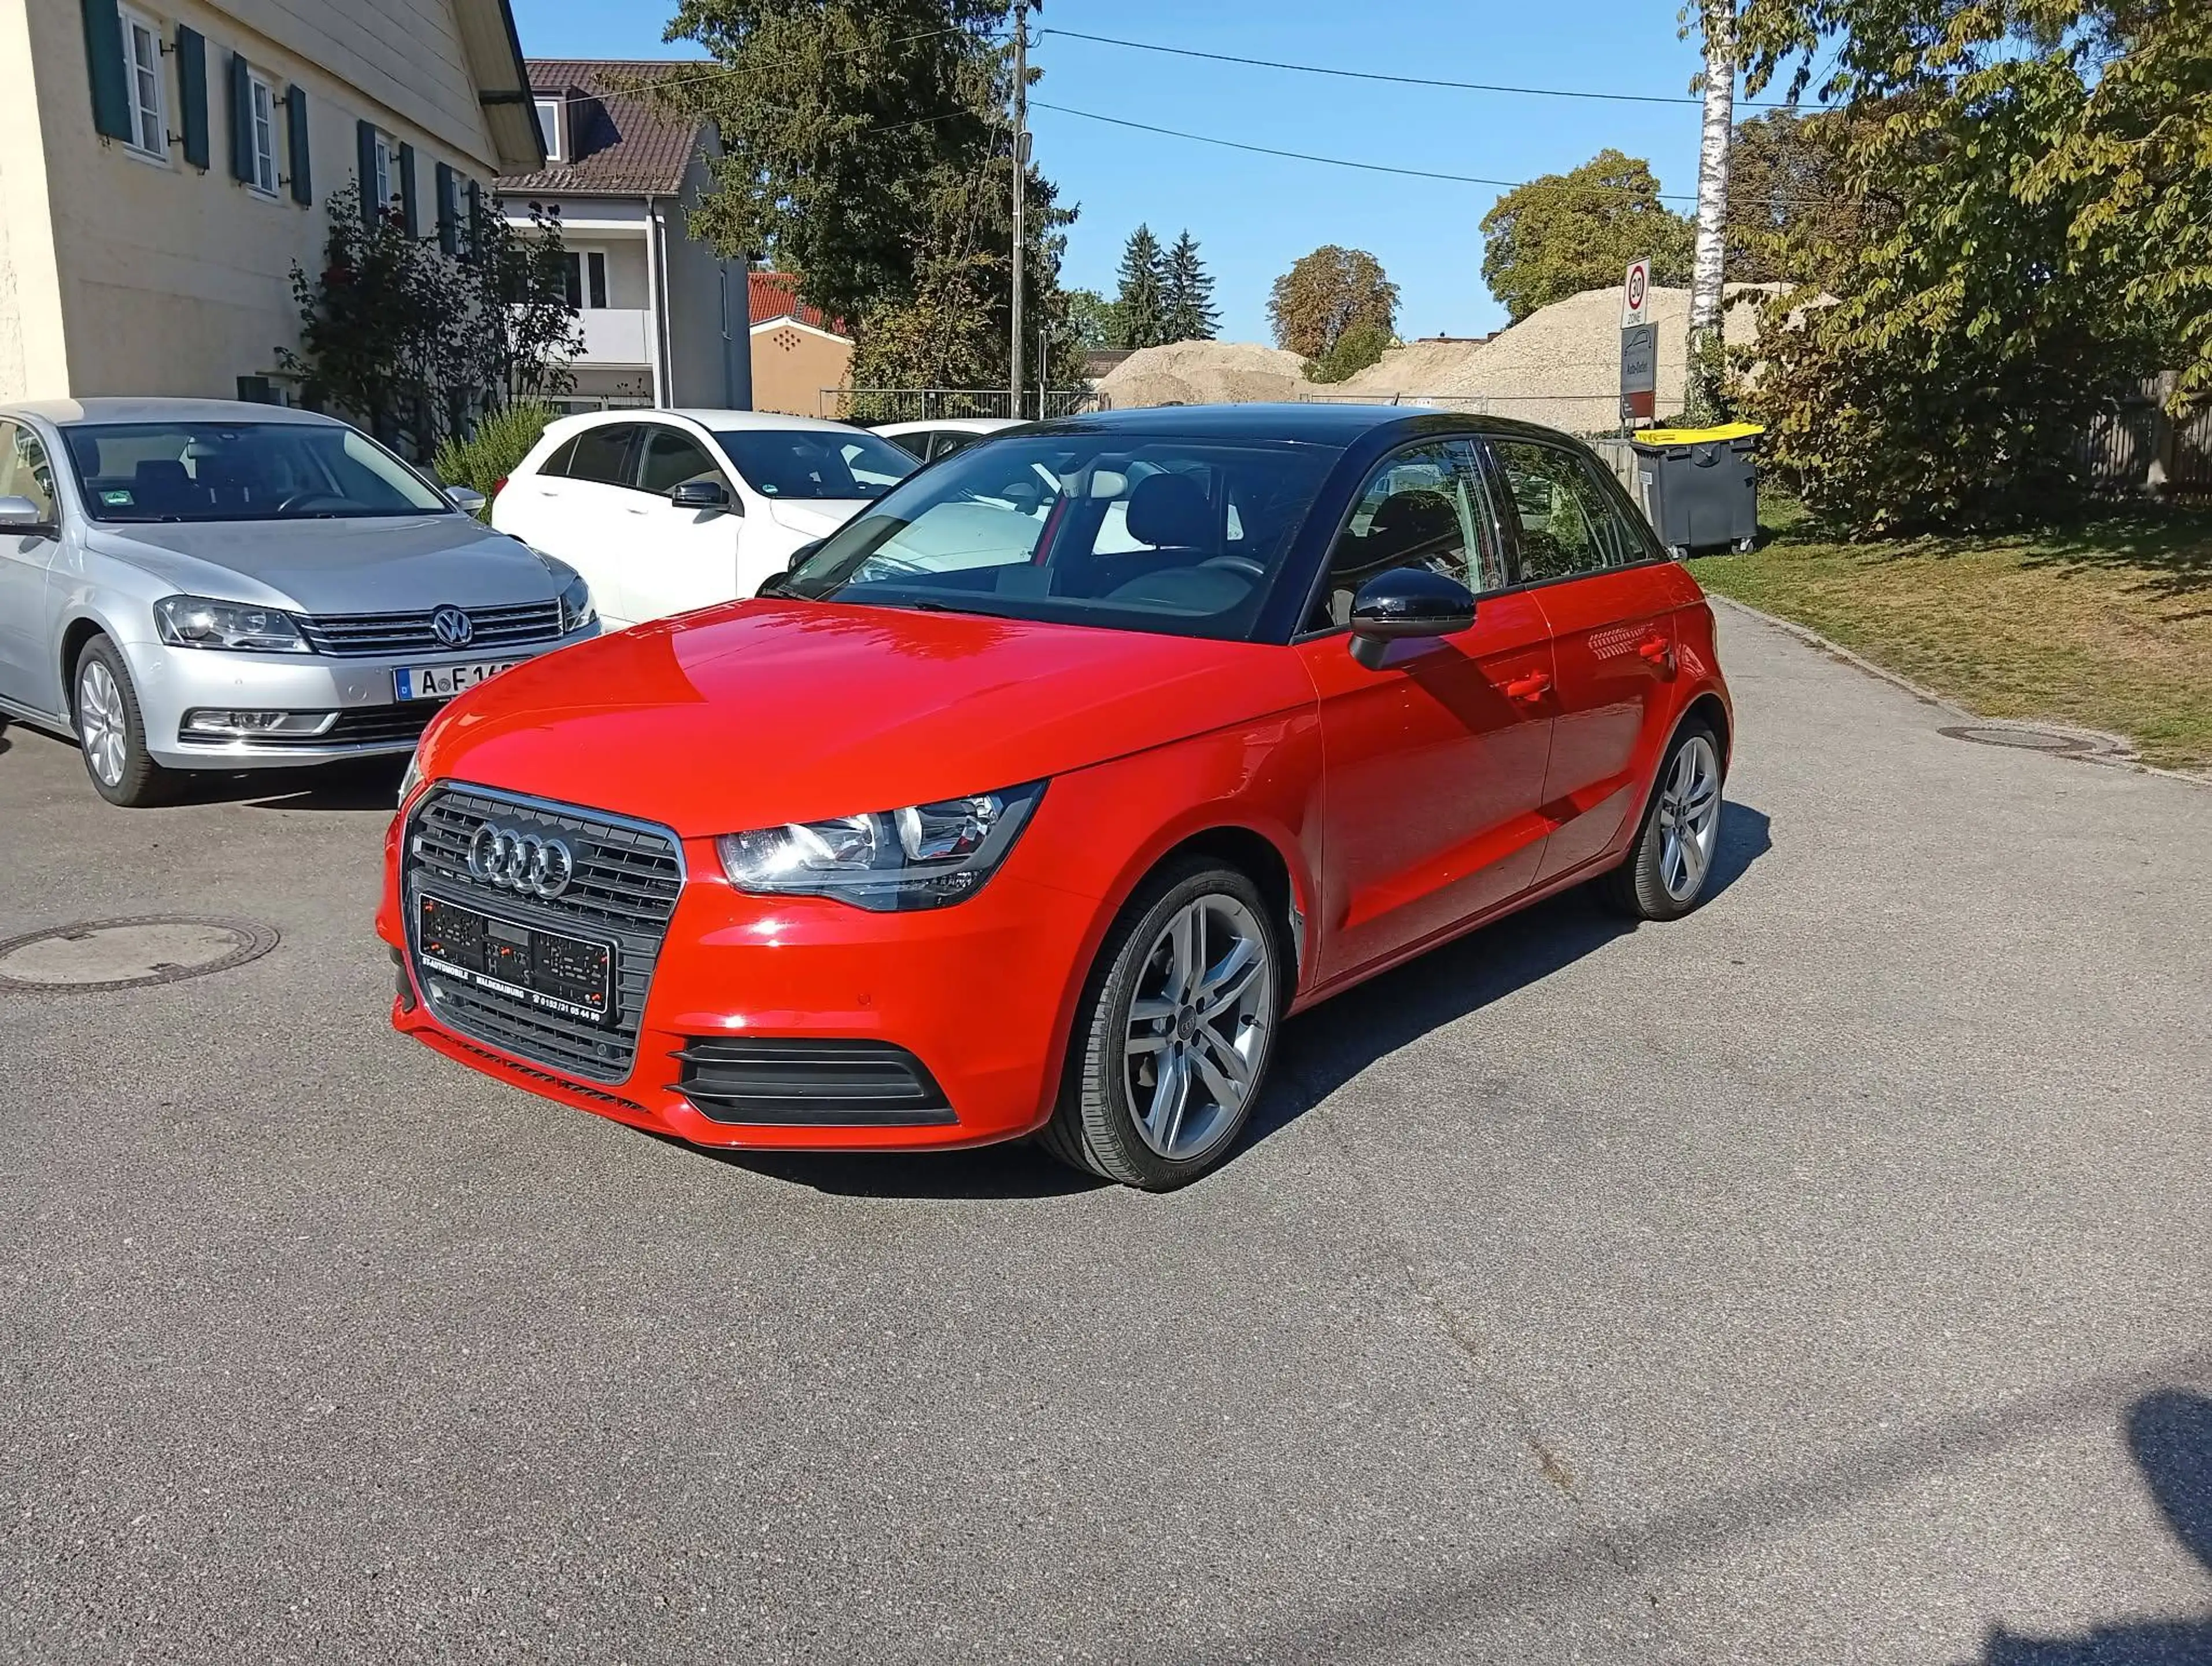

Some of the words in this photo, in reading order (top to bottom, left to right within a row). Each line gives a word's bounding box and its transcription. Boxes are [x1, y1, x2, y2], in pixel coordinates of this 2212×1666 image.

[1632, 277, 1641, 298] 30
[423, 670, 437, 694] A
[452, 668, 467, 691] F
